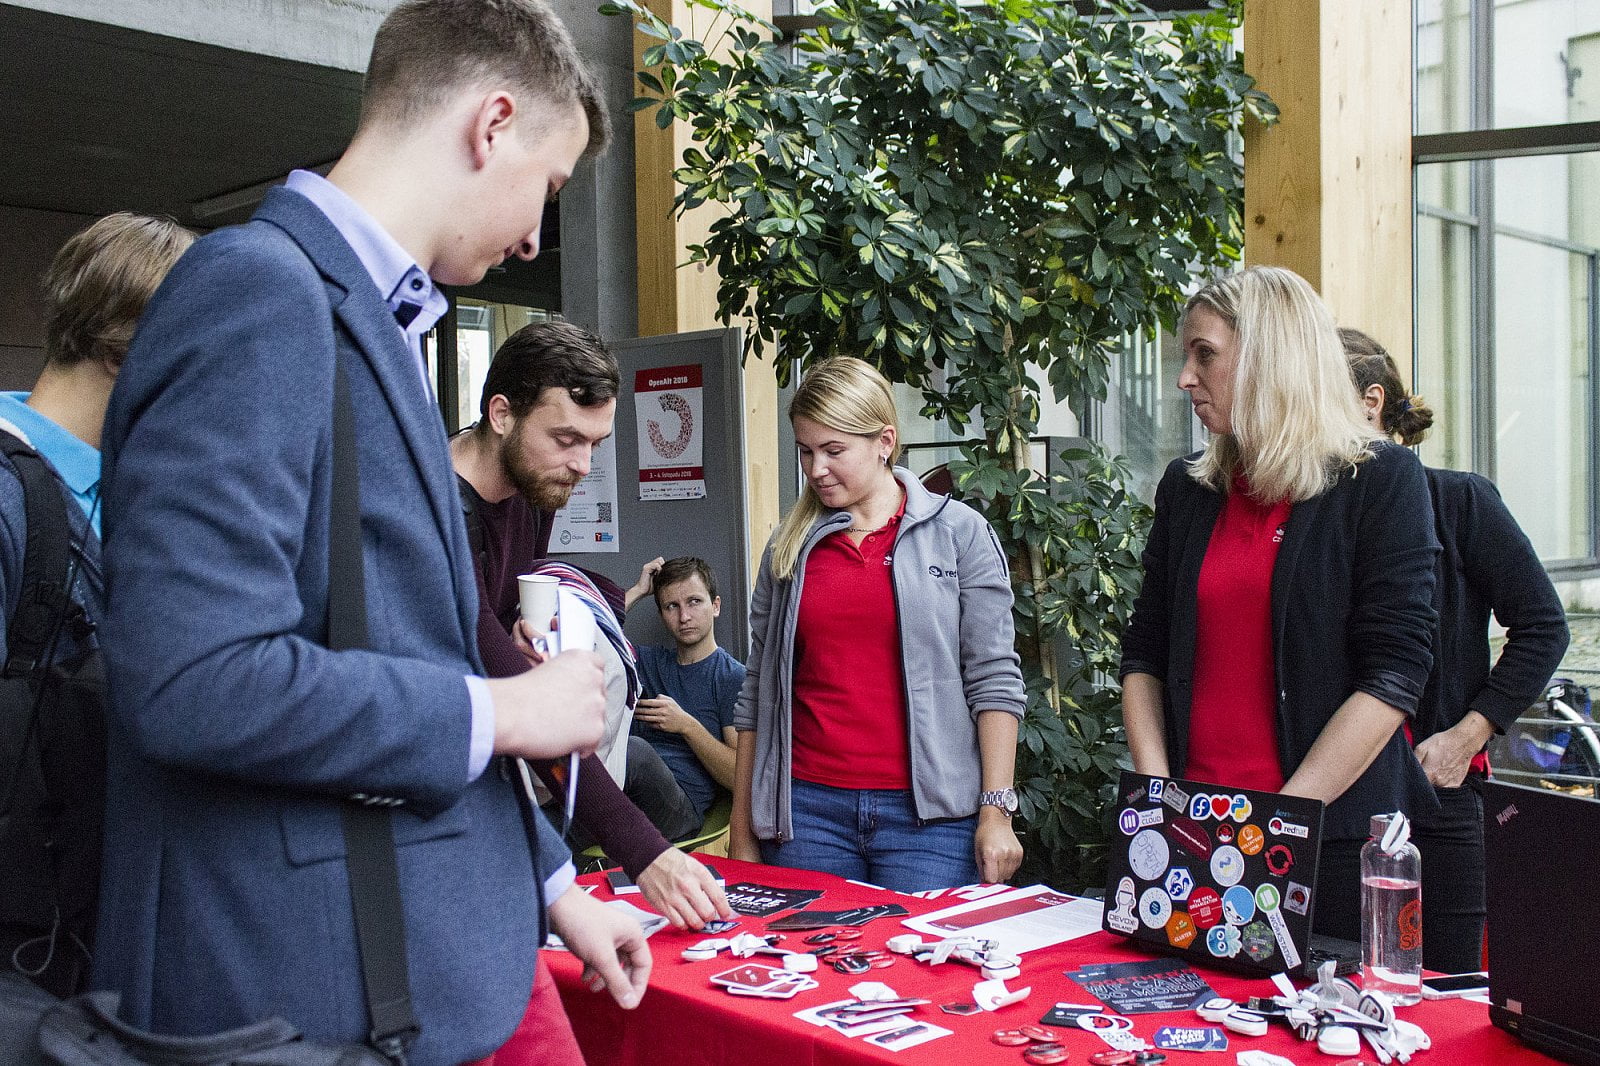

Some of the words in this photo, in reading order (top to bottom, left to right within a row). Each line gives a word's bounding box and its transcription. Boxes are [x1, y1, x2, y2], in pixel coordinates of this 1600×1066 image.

[648, 377, 672, 388] OpenAlt
[1141, 815, 1162, 826] CLOUD
[725, 892, 787, 908] HAPE
[1270, 914, 1295, 967] WORKSTATION
